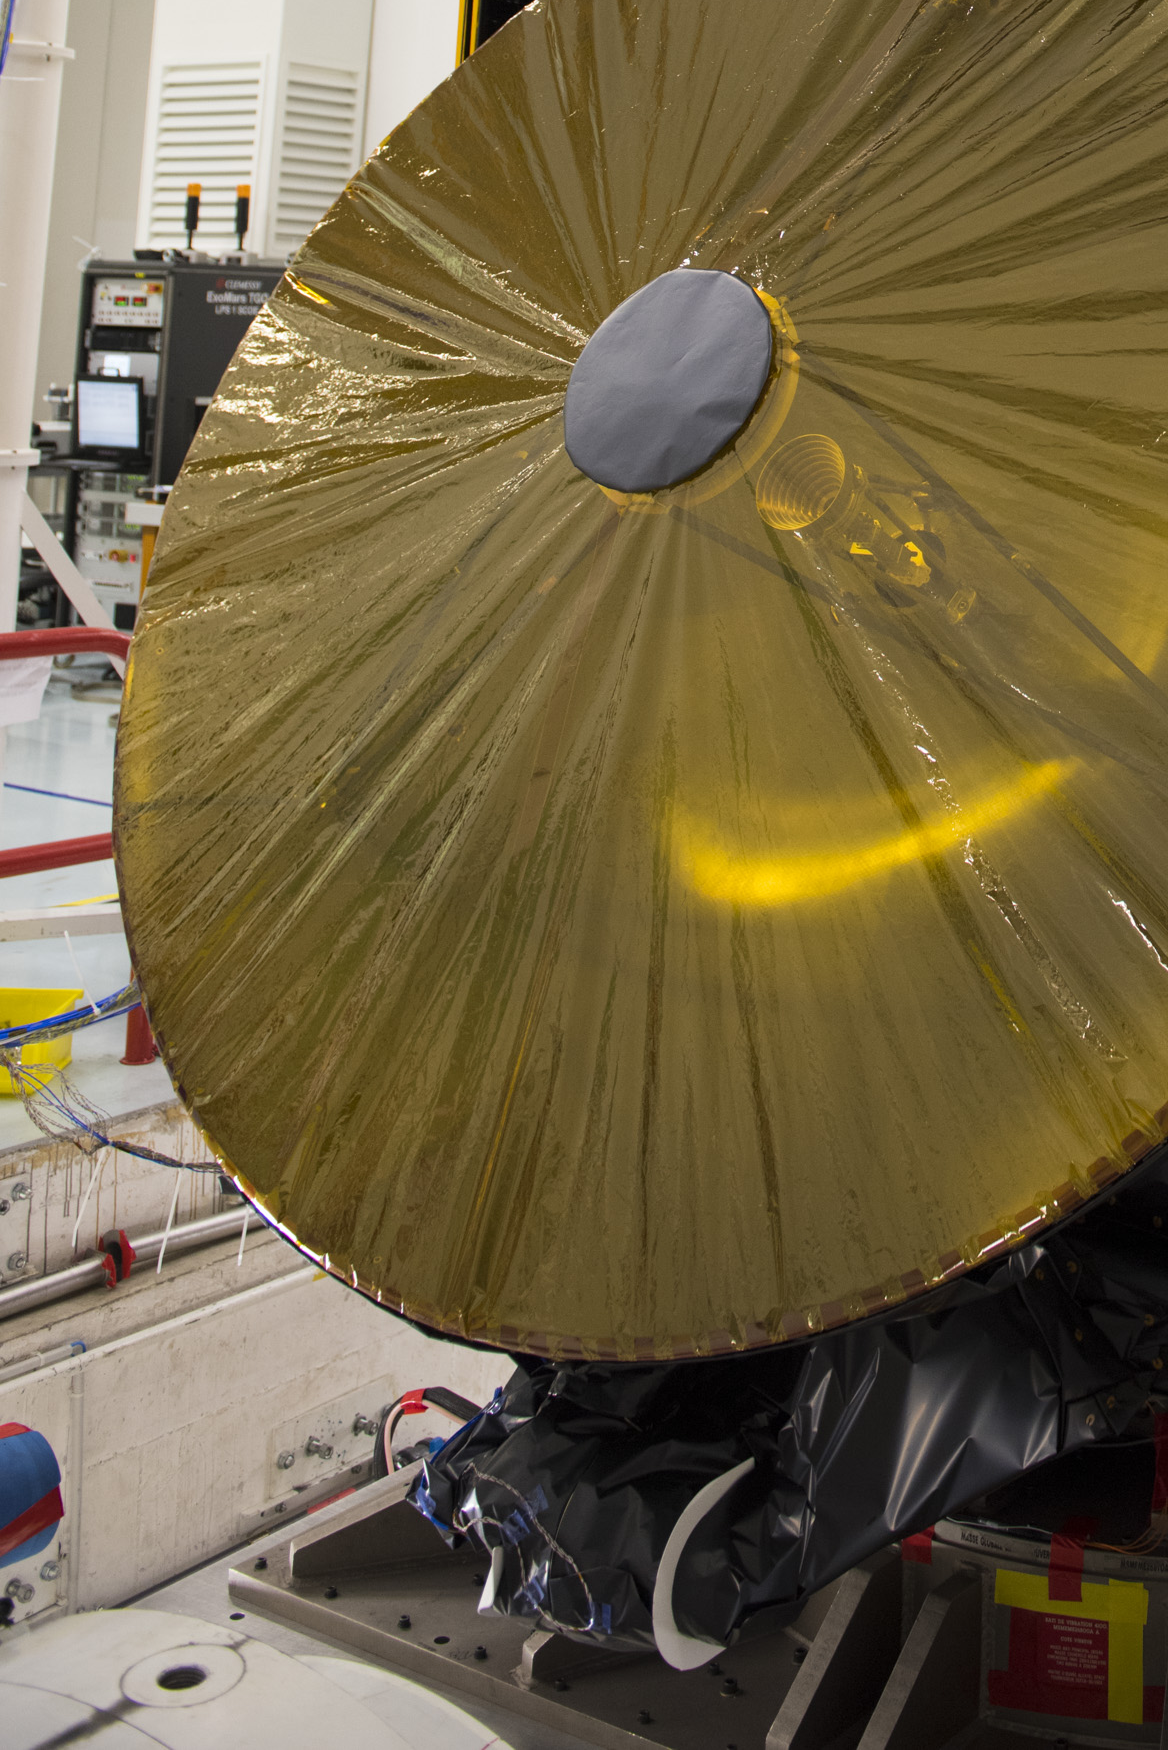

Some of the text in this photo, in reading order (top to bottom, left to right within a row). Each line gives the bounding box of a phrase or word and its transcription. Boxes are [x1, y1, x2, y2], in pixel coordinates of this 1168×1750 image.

[225, 280, 262, 290] CLEMESSY
[206, 291, 247, 304] ExoMars
[215, 305, 231, 315] LPS
